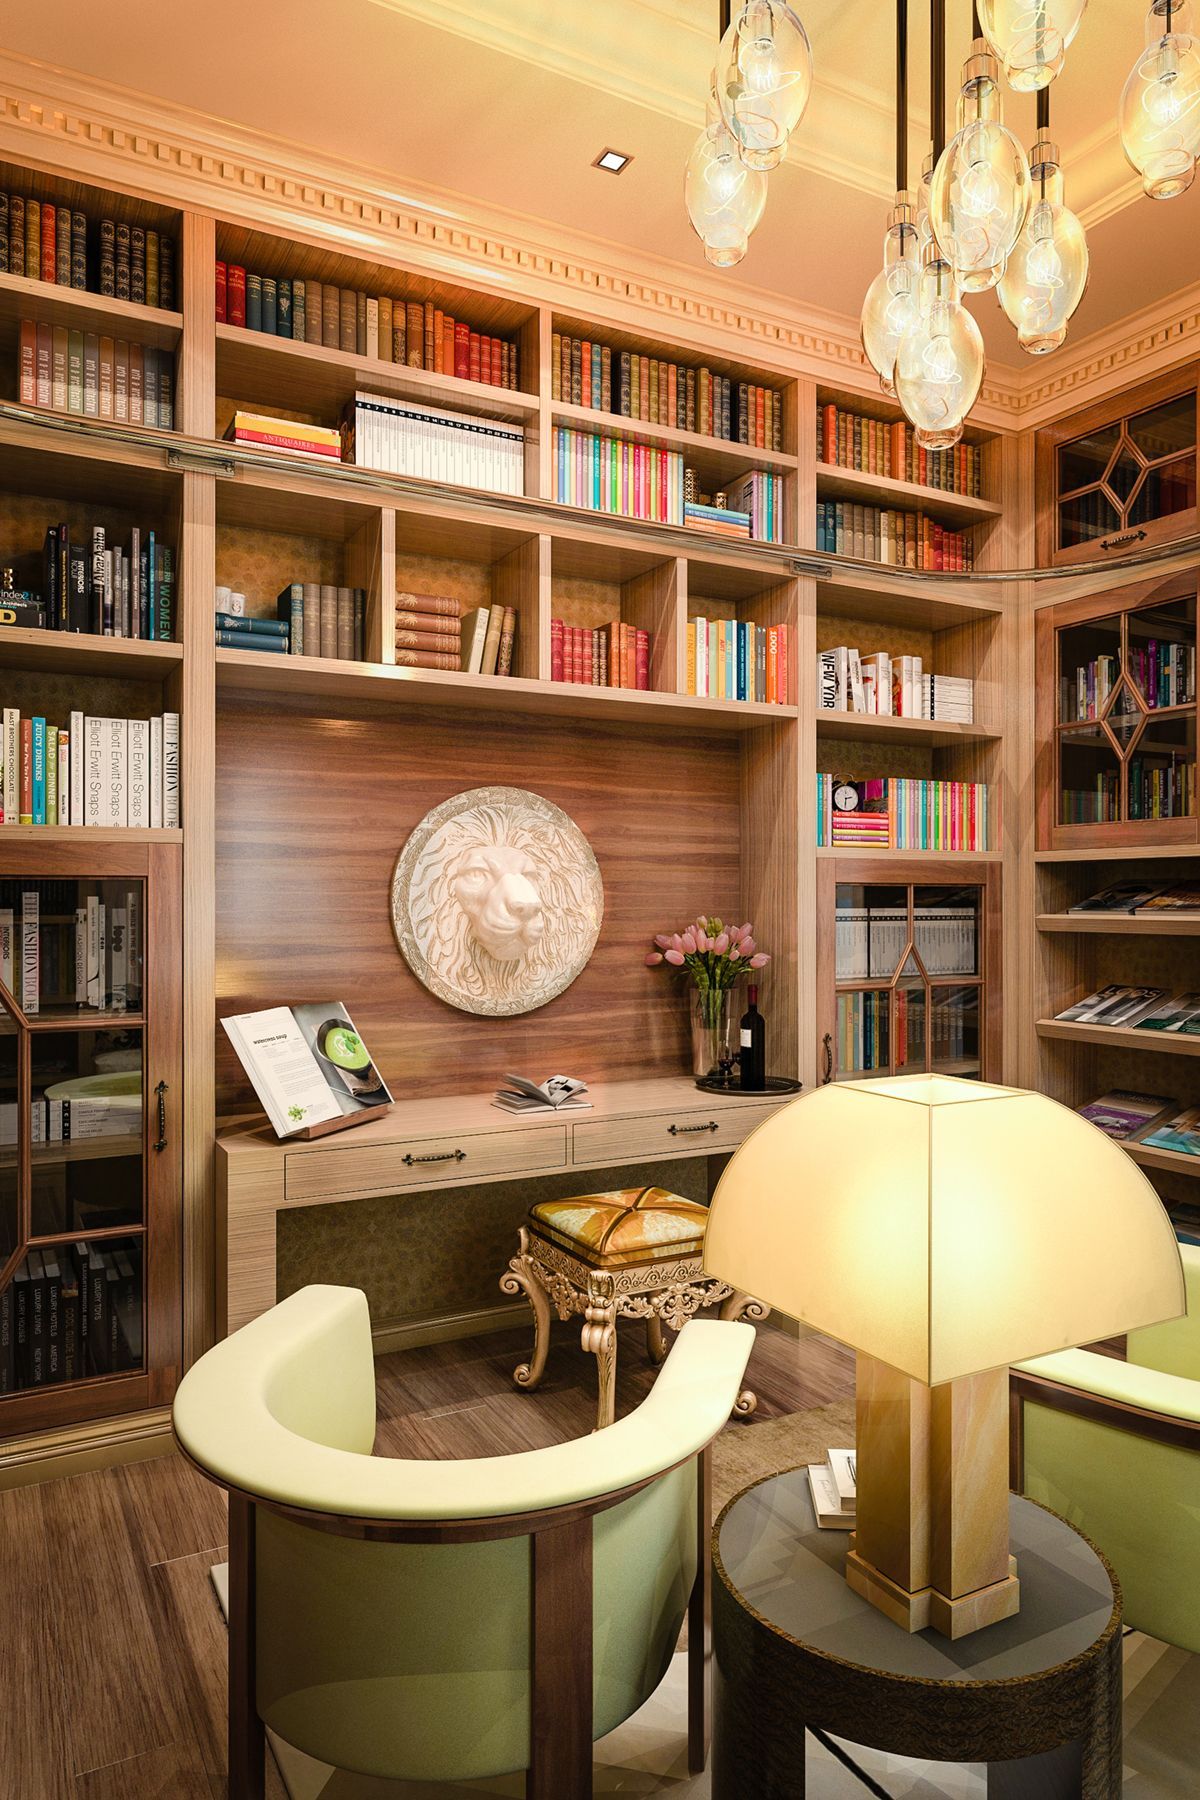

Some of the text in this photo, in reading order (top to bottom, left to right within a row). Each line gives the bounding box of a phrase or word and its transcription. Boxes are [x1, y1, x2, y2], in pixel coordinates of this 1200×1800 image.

[160, 585, 170, 639] WOMEN
[824, 685, 835, 708] YOR
[166, 715, 178, 740] THE
[88, 720, 101, 816] Elliott Erwitt Snaps
[110, 722, 122, 816] Elliott Erwitt Snaps
[132, 722, 144, 817] Elliott Erwitt Snaps
[166, 742, 178, 791] FASHION
[25, 894, 37, 919] THE
[25, 922, 37, 973] FASHION
